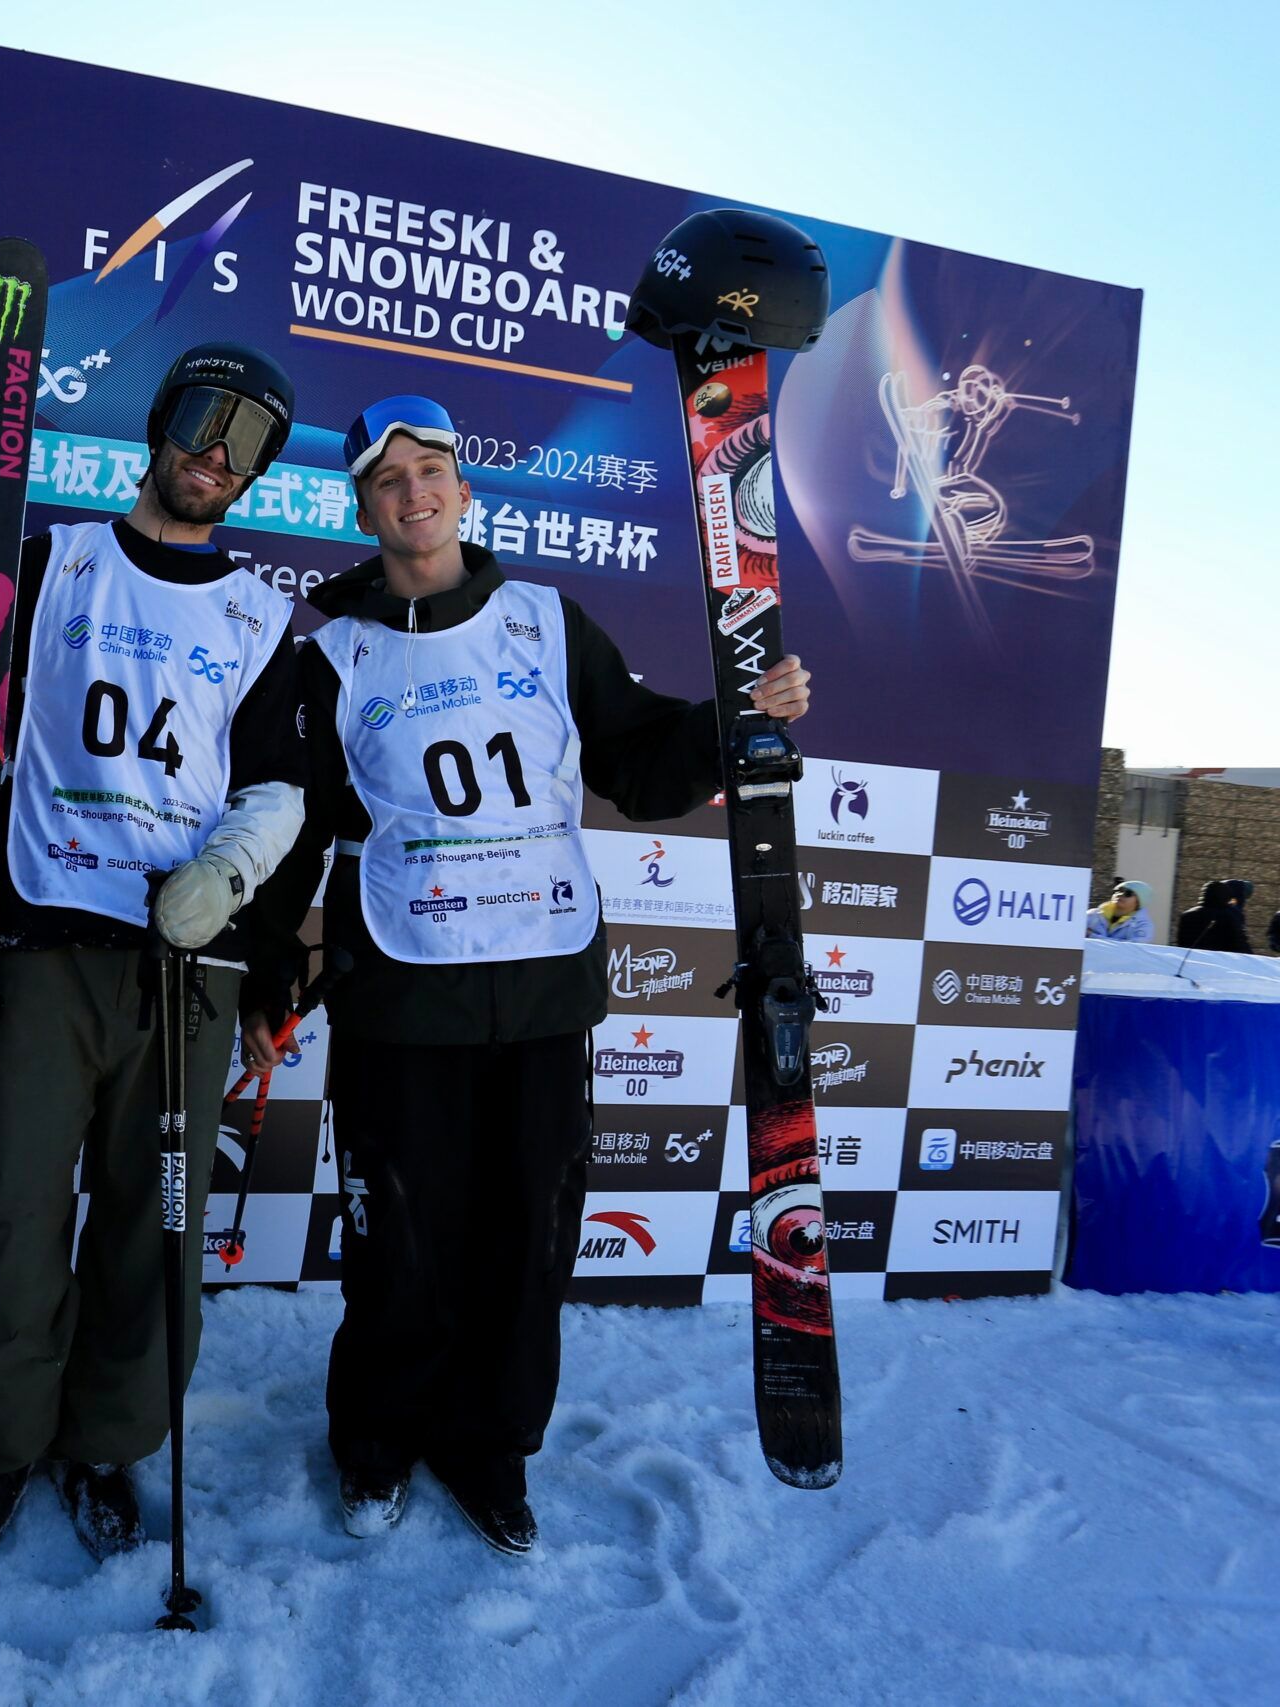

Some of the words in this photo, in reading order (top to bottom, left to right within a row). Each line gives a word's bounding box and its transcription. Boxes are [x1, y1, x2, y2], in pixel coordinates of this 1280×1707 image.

[298, 182, 511, 262] FREESKI
[529, 230, 565, 274] &
[294, 232, 632, 331] SNOWBOARD
[291, 281, 440, 339] WORLD
[450, 313, 524, 354] CUP
[263, 392, 288, 419] GIRO
[453, 432, 658, 494] 2023-2024赛季
[708, 482, 732, 579] RAIFFEISEN
[101, 622, 173, 651] 中国移动
[98, 641, 131, 659] China
[133, 649, 168, 664] Mobile
[405, 704, 440, 719] China
[442, 694, 482, 710] Mobile
[82, 679, 184, 779] 04
[422, 731, 532, 817] 01
[51, 803, 65, 813] FIS
[81, 809, 155, 832] Shougang-Beijing
[989, 813, 1046, 831] Heineken
[817, 829, 844, 842] luckin
[847, 832, 875, 844] coffee
[404, 855, 418, 866] FIS
[421, 854, 435, 864] BA
[436, 848, 521, 863] Shougang-Beijing
[413, 900, 464, 912] Heineken
[476, 891, 529, 905] swatch
[822, 881, 898, 908] 移动爱家
[997, 890, 1073, 922] HALTI
[814, 974, 868, 991] ineken
[966, 973, 1023, 992] 中国移动
[965, 992, 991, 1004] China
[992, 993, 1021, 1005] Mobile
[600, 1055, 678, 1072] Heineken
[945, 1049, 1046, 1084] phenix
[626, 1079, 648, 1097] 0.0
[592, 1152, 612, 1164] hina
[614, 1152, 648, 1164] Mobile
[960, 1141, 1054, 1161] 中国移动云盘
[173, 1155, 185, 1228] FACTION
[824, 1221, 876, 1241] 动云盘
[933, 1219, 1020, 1244] SMITH
[578, 1238, 627, 1259] ANTA
